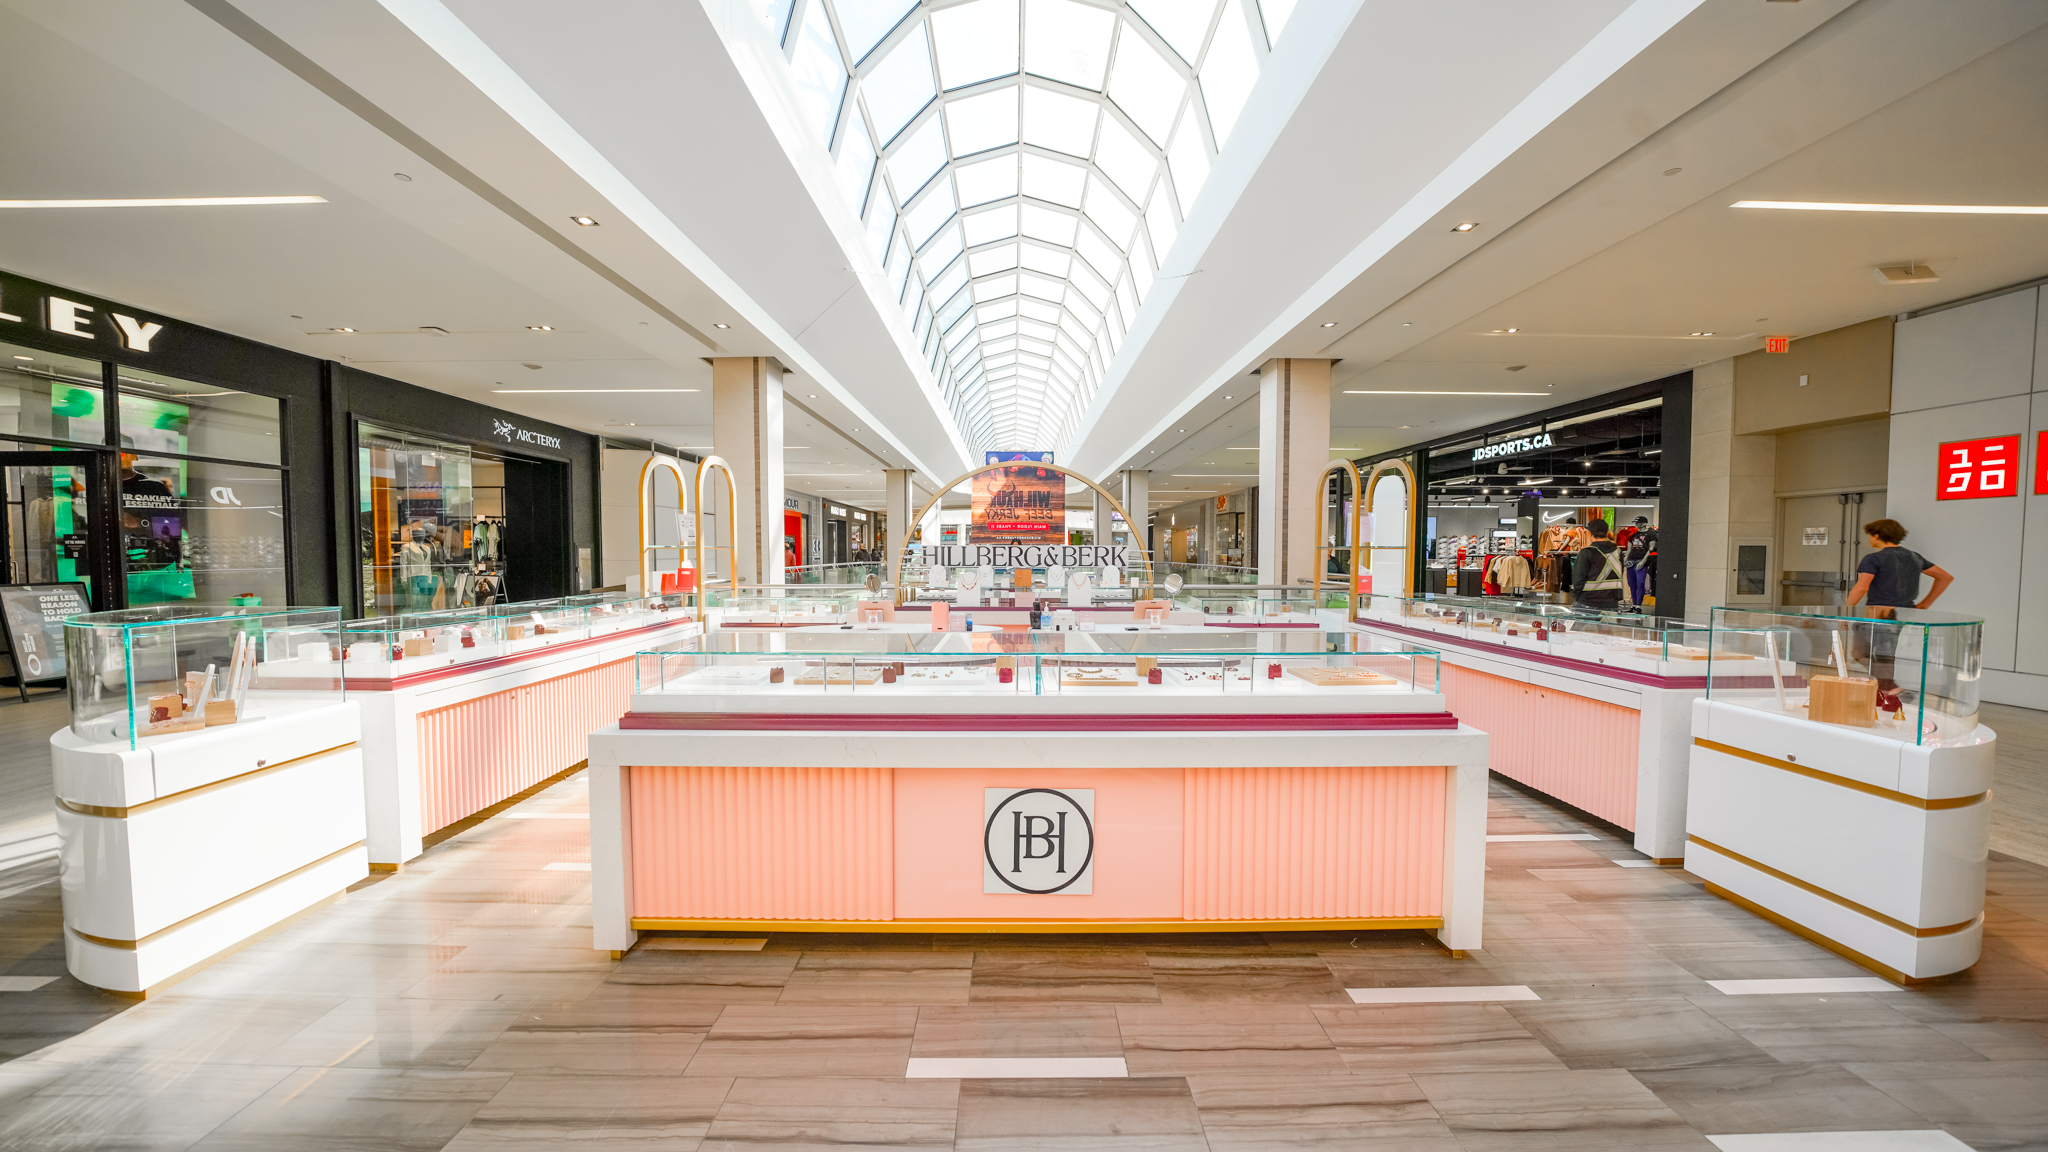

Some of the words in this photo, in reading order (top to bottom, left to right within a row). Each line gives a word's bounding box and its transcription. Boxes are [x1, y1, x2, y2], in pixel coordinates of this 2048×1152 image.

[1769, 338, 1787, 353] EXIT
[1472, 433, 1553, 461] JDSPORTS.CA
[134, 494, 173, 503] OAKLEY
[125, 501, 179, 509] ESSENTIALS
[922, 545, 1128, 567] HILLBERG&BERK
[40, 601, 78, 609] REASON
[56, 607, 82, 615] HOLD
